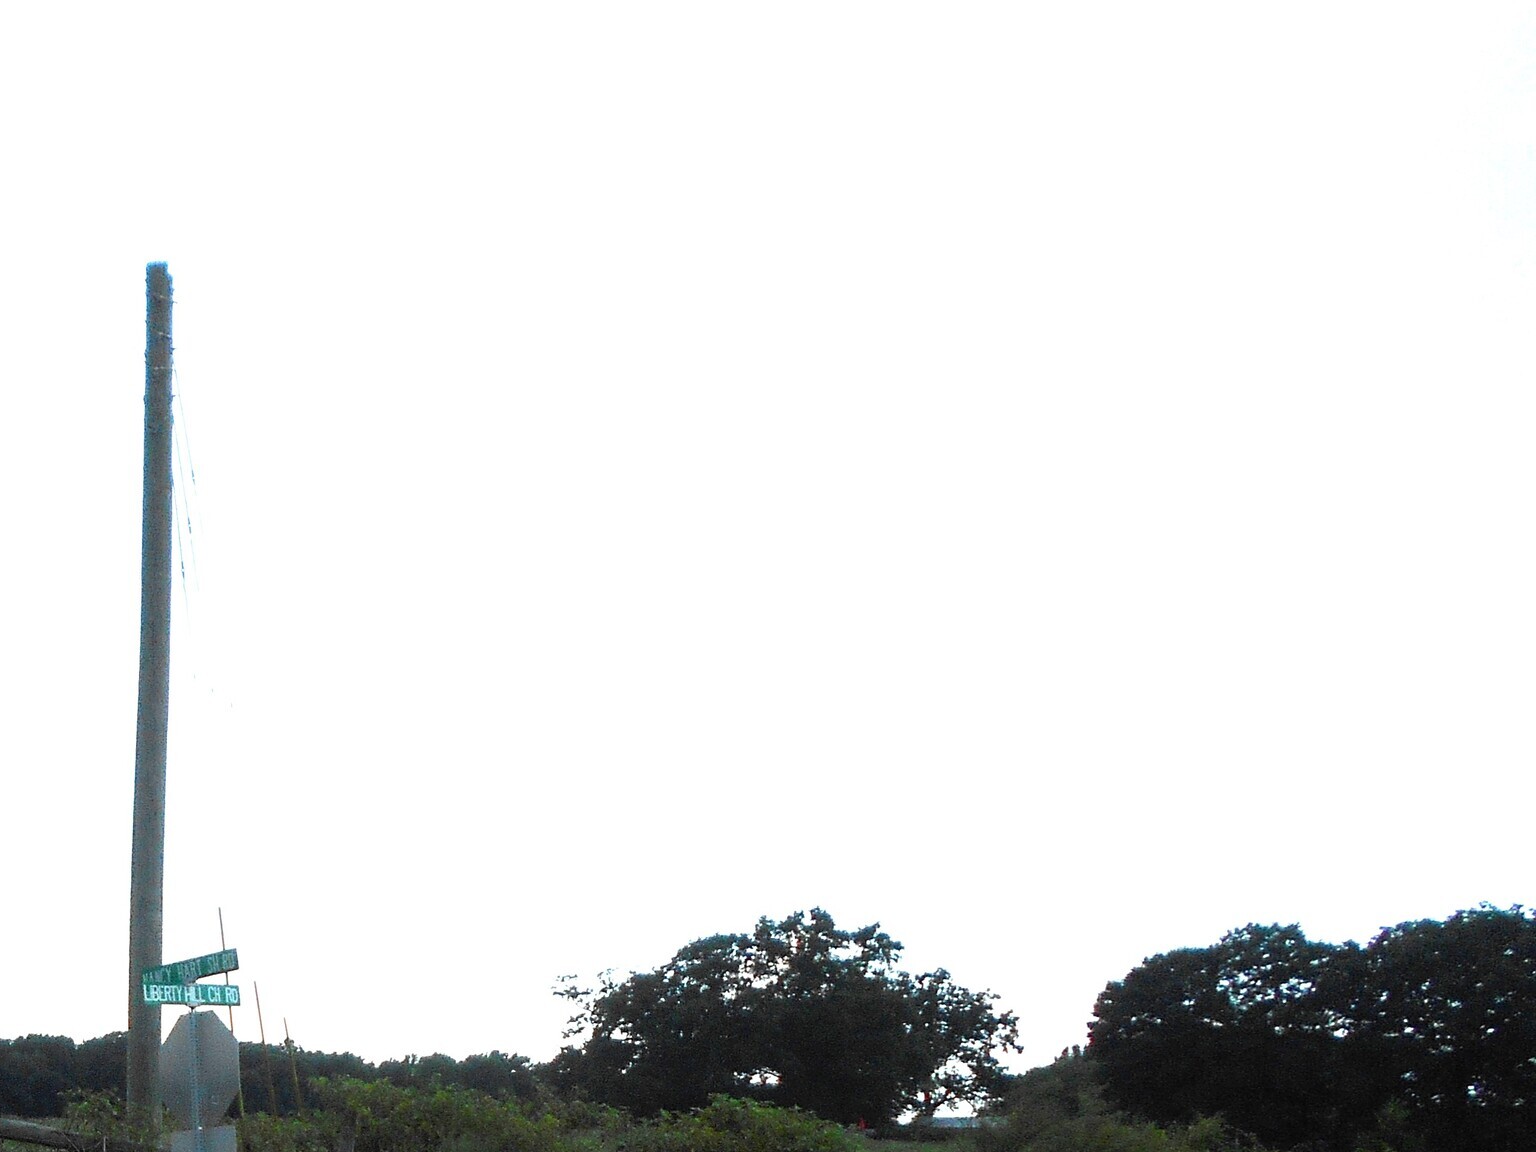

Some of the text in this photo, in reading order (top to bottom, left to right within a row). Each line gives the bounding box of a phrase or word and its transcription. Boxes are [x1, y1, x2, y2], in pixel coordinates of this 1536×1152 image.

[177, 959, 202, 979] HART
[143, 985, 238, 1003] LIBERTY HILL CH RD
